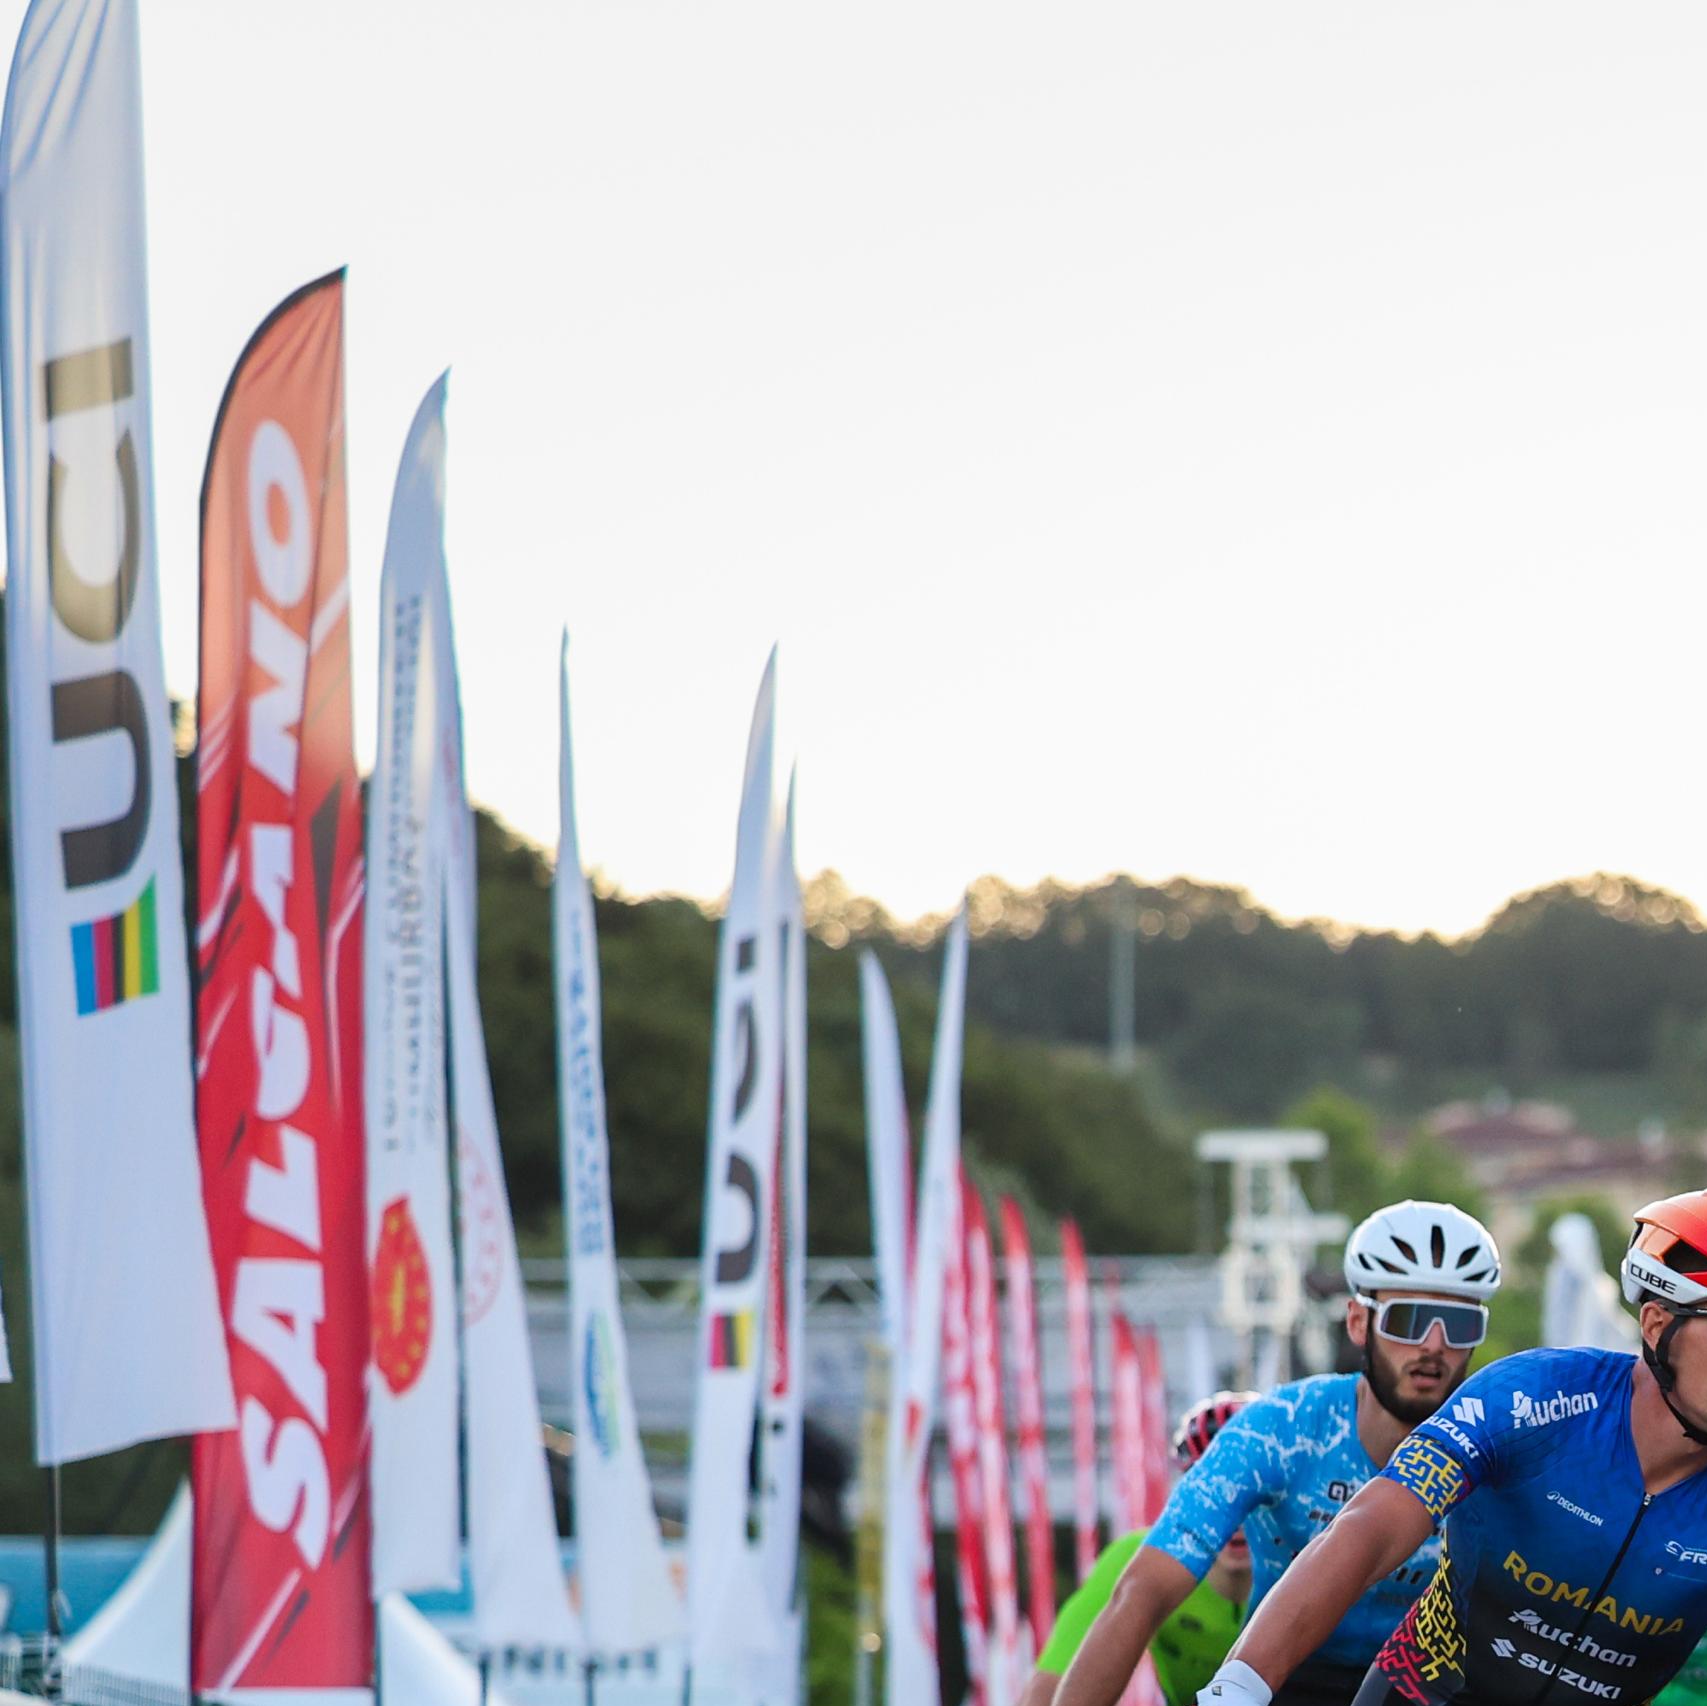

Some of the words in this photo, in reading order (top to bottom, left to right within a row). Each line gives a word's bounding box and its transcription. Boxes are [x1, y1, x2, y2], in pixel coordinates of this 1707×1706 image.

[41, 337, 153, 890] UCI
[1631, 1262, 1676, 1295] CUBE
[1510, 1389, 1598, 1429] Auchan
[1557, 1496, 1603, 1527] DECATHLON
[1503, 1550, 1685, 1636] ROMANIA
[1508, 1608, 1637, 1668] Auchan
[1518, 1652, 1622, 1700] SUZUKI
